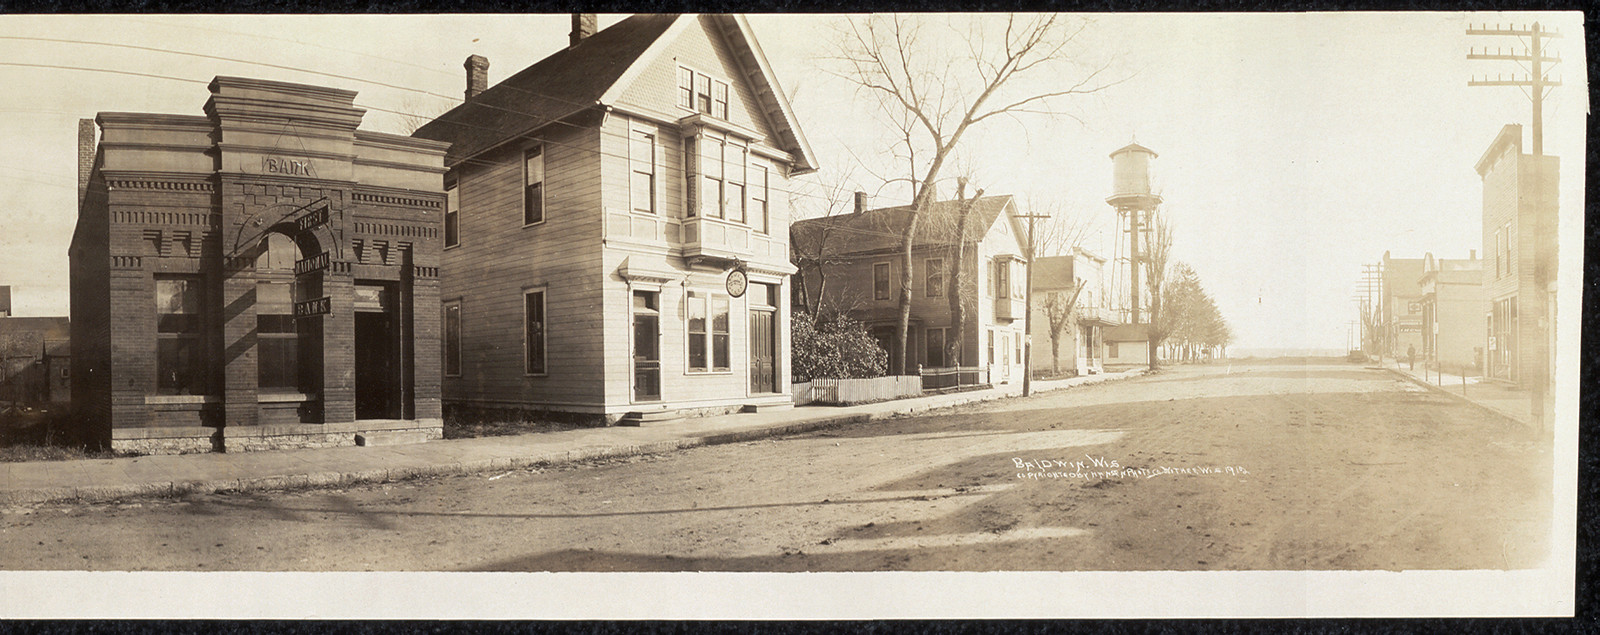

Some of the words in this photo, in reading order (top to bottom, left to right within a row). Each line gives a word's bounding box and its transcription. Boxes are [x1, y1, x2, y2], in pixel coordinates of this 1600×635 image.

[268, 158, 310, 177] BANK
[298, 210, 324, 231] FIRST
[295, 253, 329, 275] NATIONAL
[296, 299, 327, 315] BANK
